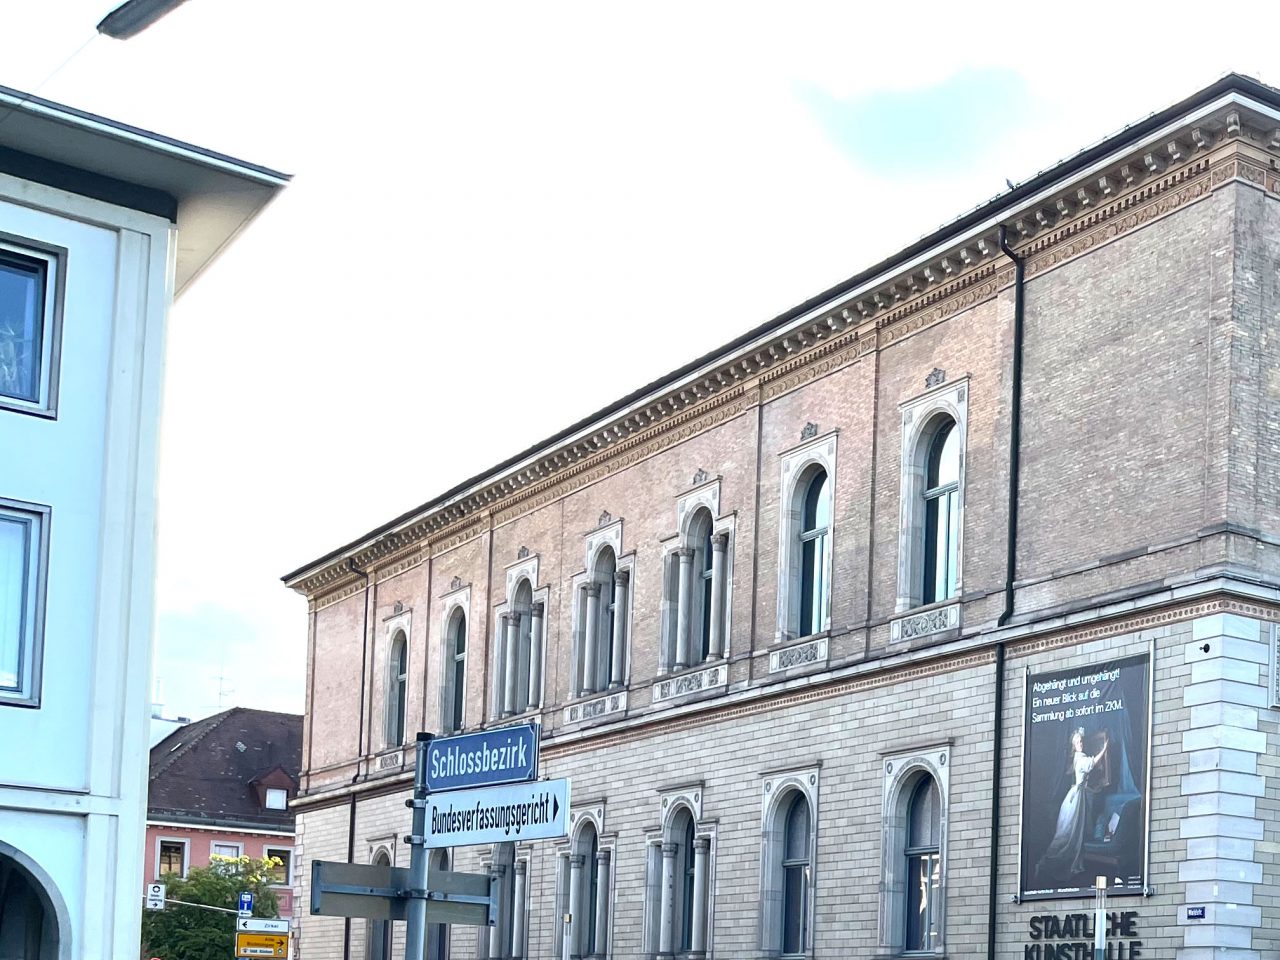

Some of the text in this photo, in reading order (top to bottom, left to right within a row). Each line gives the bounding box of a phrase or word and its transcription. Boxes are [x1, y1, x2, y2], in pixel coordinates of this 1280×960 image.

[1033, 668, 1120, 693] Abgehängt und umgehängt!
[1032, 687, 1101, 708] Ein neuer Blick auf die
[1032, 699, 1124, 723] Sammlung ab sofort im ZKM.
[431, 736, 527, 779] Schlossbezirk
[431, 792, 549, 836] Bundesverfassungsgericht
